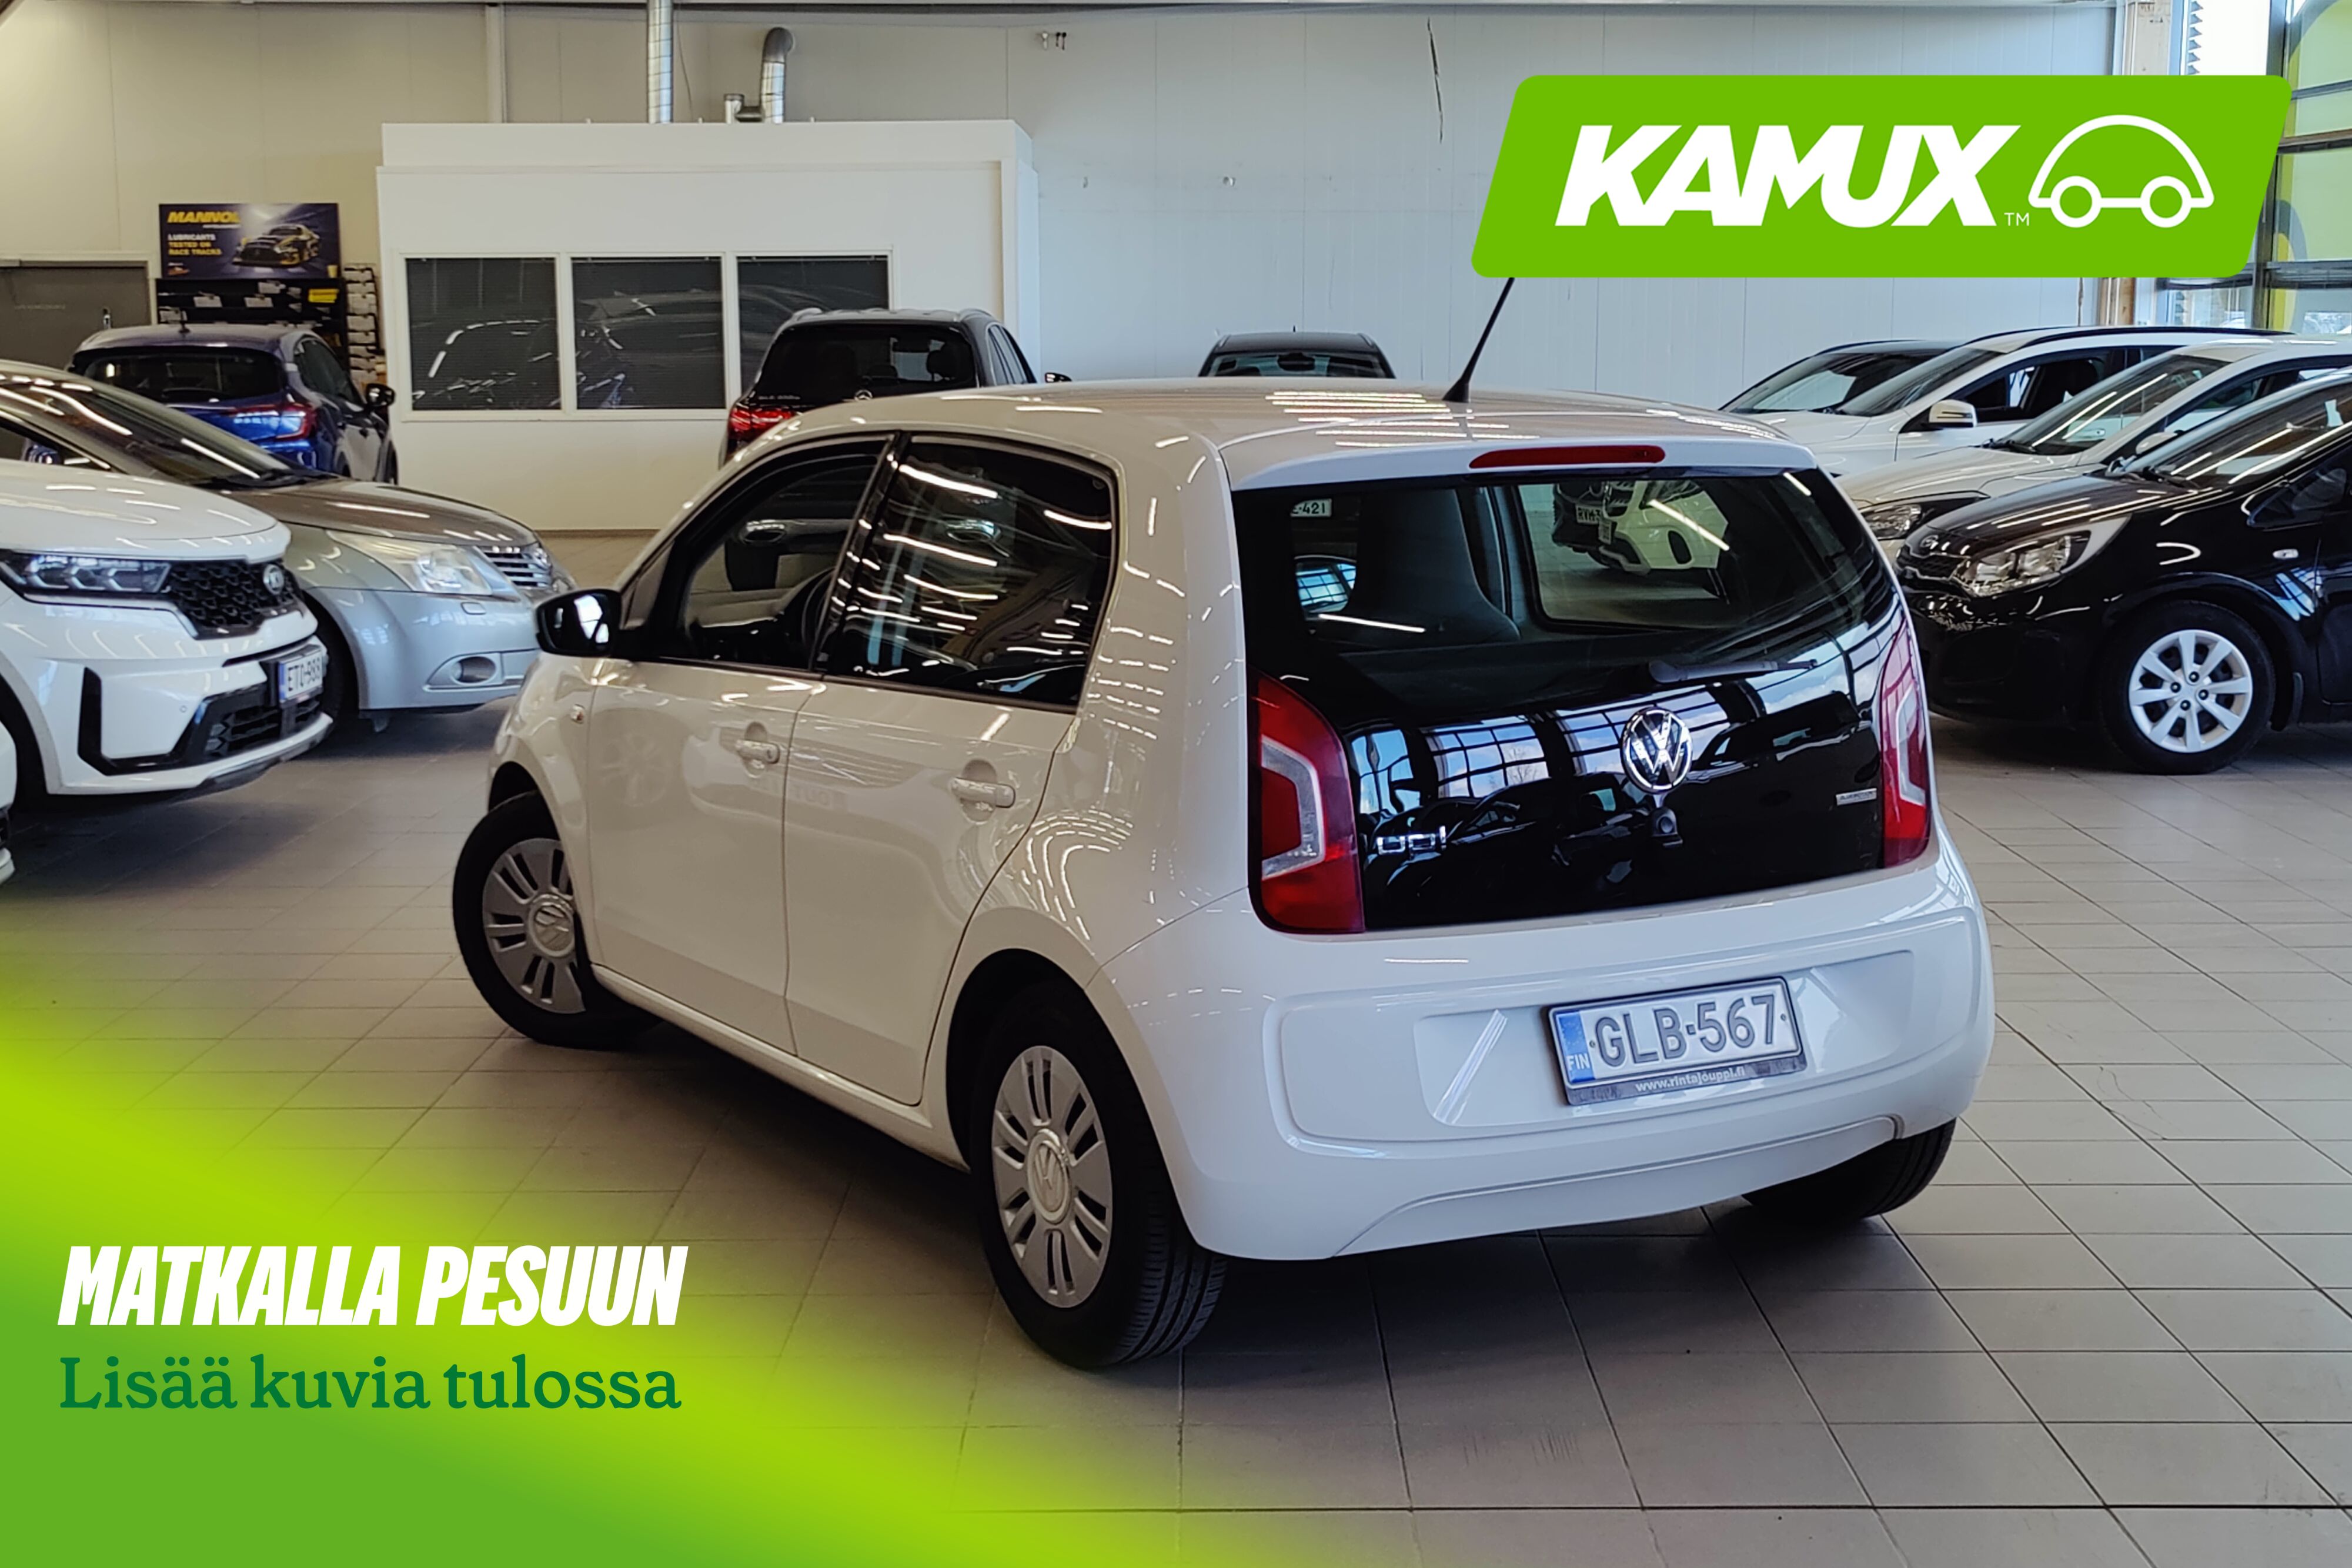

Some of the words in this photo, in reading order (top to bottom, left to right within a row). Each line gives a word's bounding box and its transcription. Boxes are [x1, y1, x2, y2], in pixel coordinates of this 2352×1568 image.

[167, 211, 240, 223] MANNOL
[1595, 994, 1776, 1067] GLB-567
[1566, 1053, 1591, 1071] FIN
